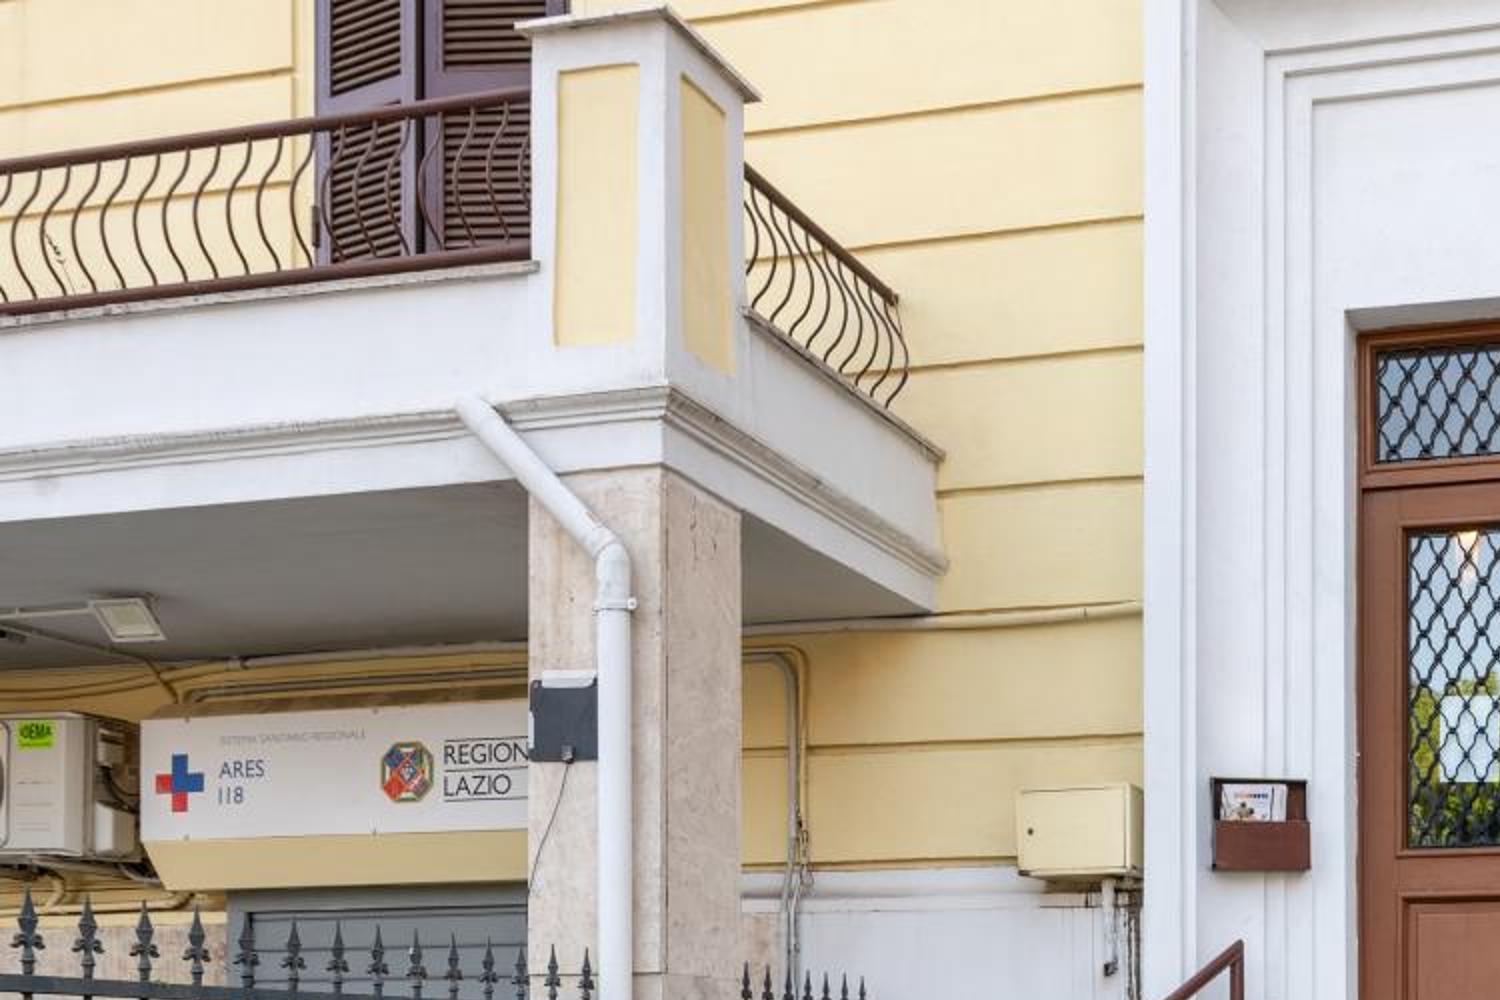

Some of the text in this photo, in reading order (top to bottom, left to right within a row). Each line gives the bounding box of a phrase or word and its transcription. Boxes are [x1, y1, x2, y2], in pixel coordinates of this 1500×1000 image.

[443, 741, 529, 765] REGION
[218, 759, 265, 779] ARES
[217, 786, 245, 806] 118
[443, 773, 511, 797] LAZIO
